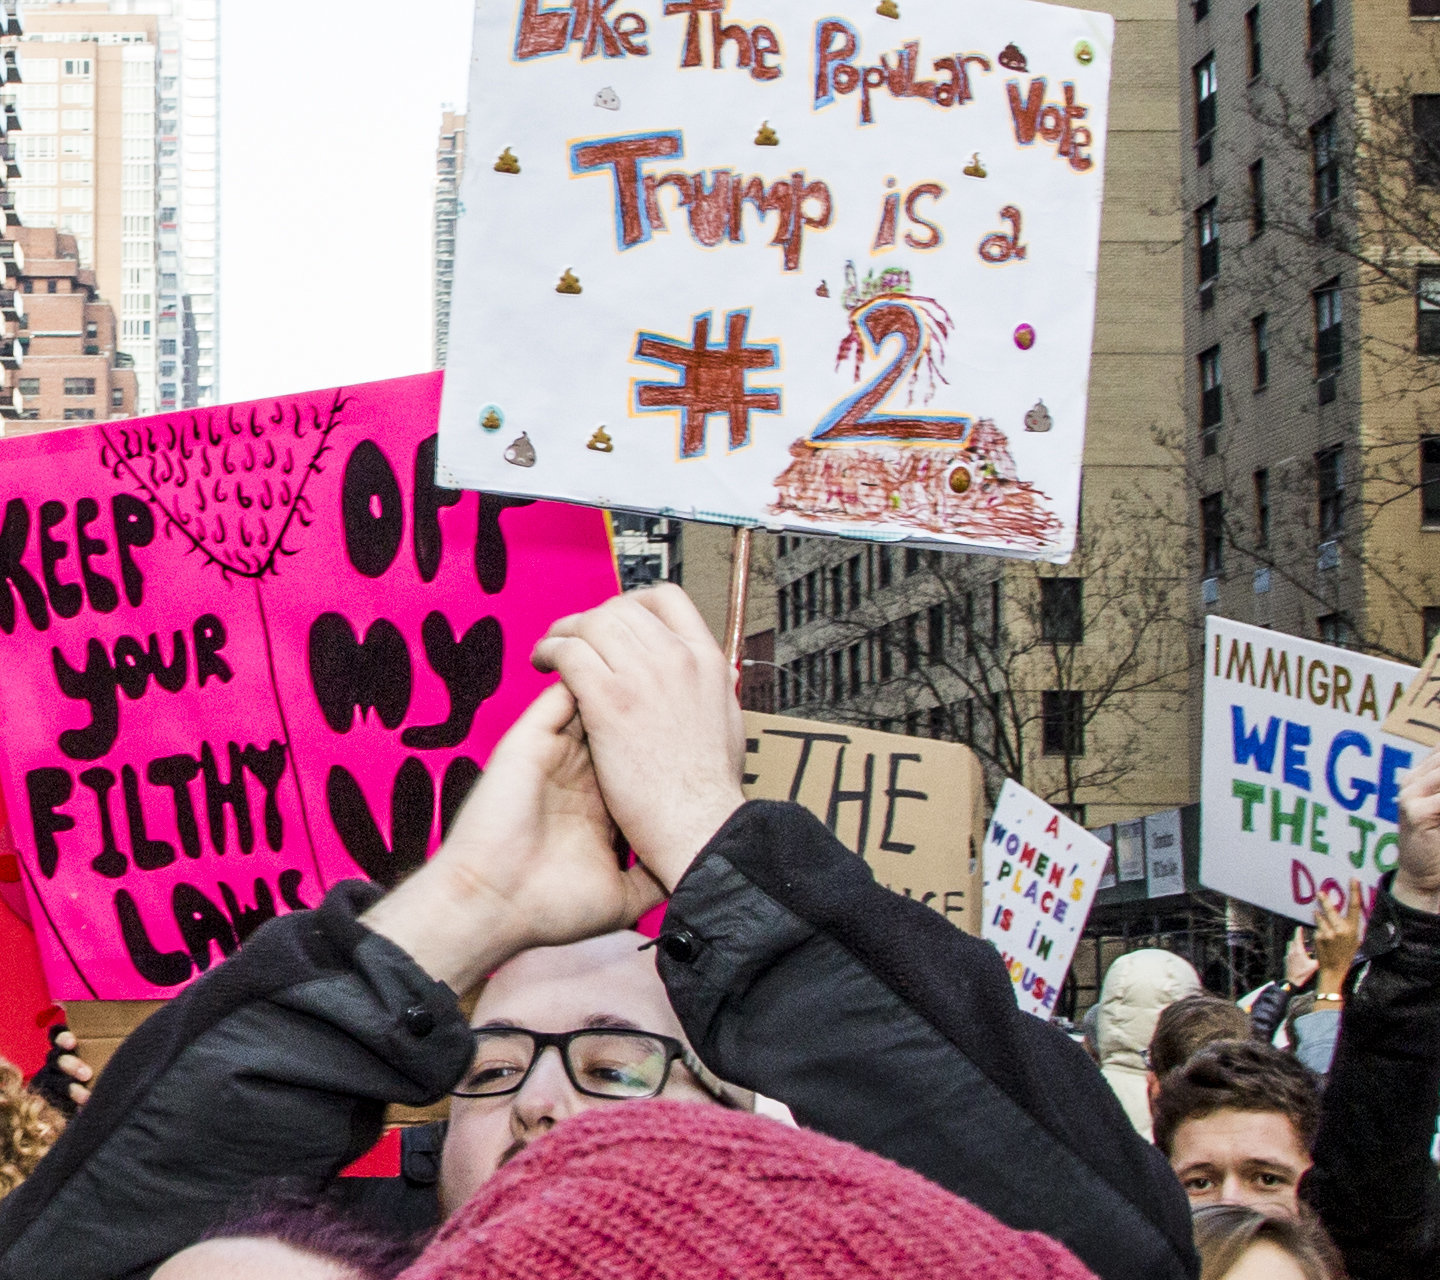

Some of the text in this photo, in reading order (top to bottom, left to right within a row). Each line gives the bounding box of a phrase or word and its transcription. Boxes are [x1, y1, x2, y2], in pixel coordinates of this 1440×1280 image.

[1006, 77, 1094, 171] Vote
[571, 129, 1028, 271] Trump is a
[1230, 704, 1312, 792] WE
[26, 740, 290, 880] FILTHY
[763, 729, 927, 858] THE
[1045, 814, 1059, 839] A
[1232, 778, 1330, 855] THE
[991, 821, 1084, 902] WOMEN'S
[998, 860, 1068, 922] PLACE
[992, 905, 1014, 932] IS
